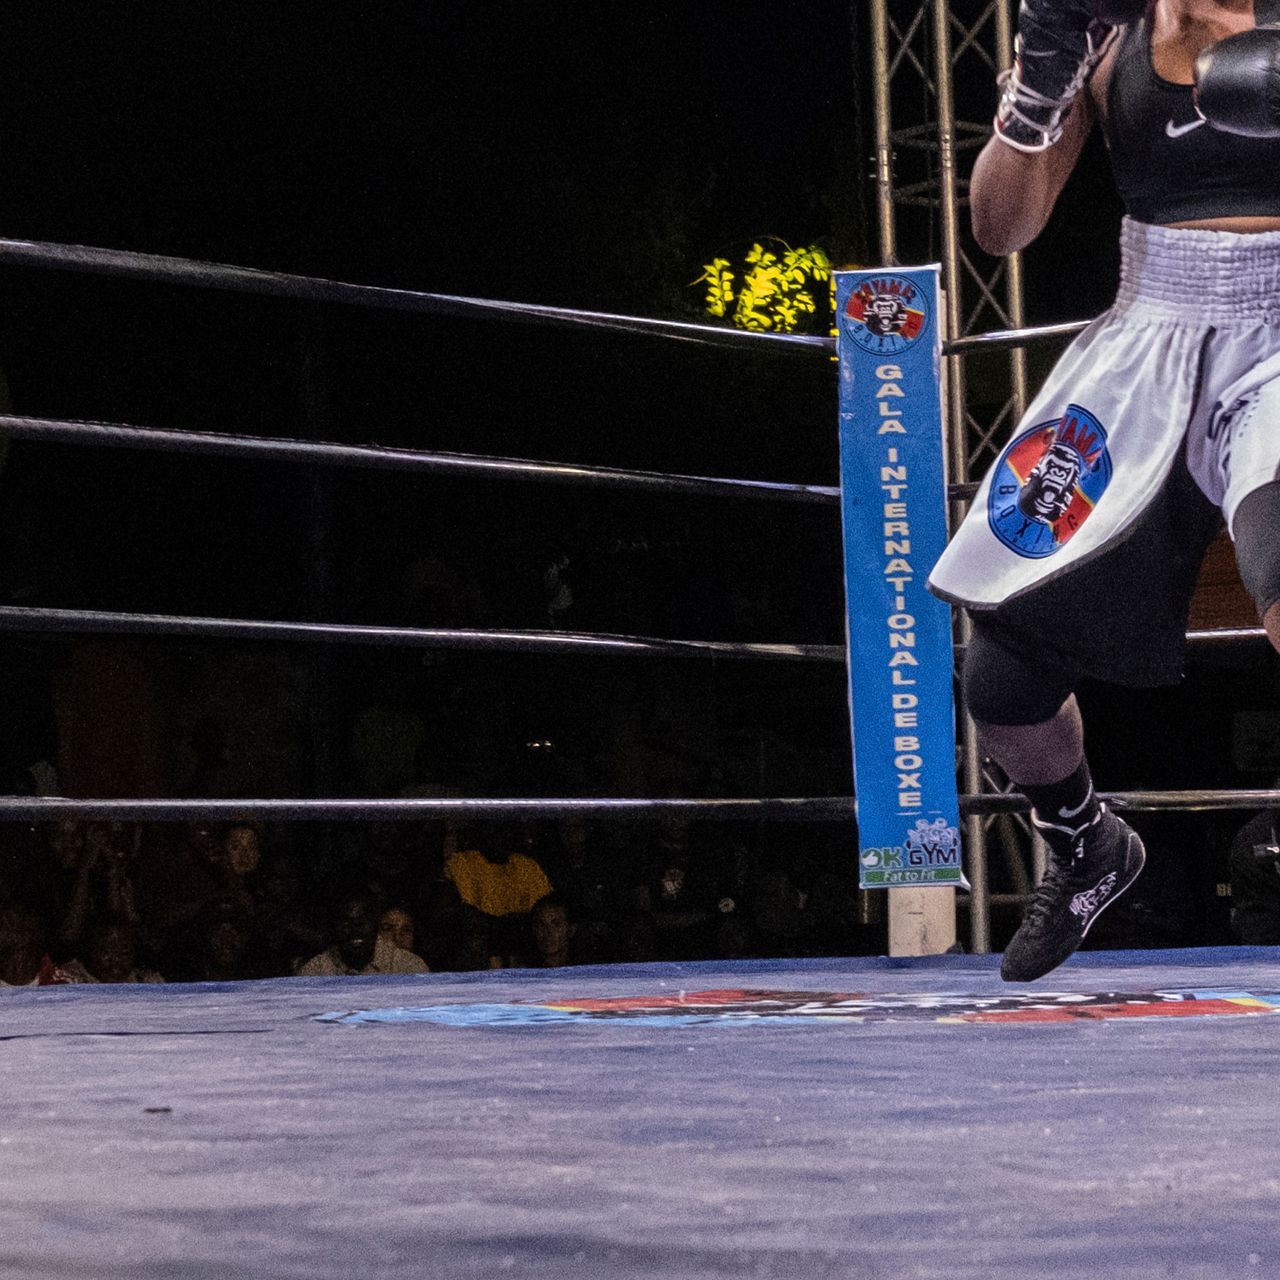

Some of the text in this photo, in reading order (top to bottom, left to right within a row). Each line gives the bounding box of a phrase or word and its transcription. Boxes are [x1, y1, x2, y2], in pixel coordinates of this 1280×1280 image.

[875, 364, 923, 807] GALA INTERNATIONAL DE BOXE
[910, 843, 957, 865] GYM
